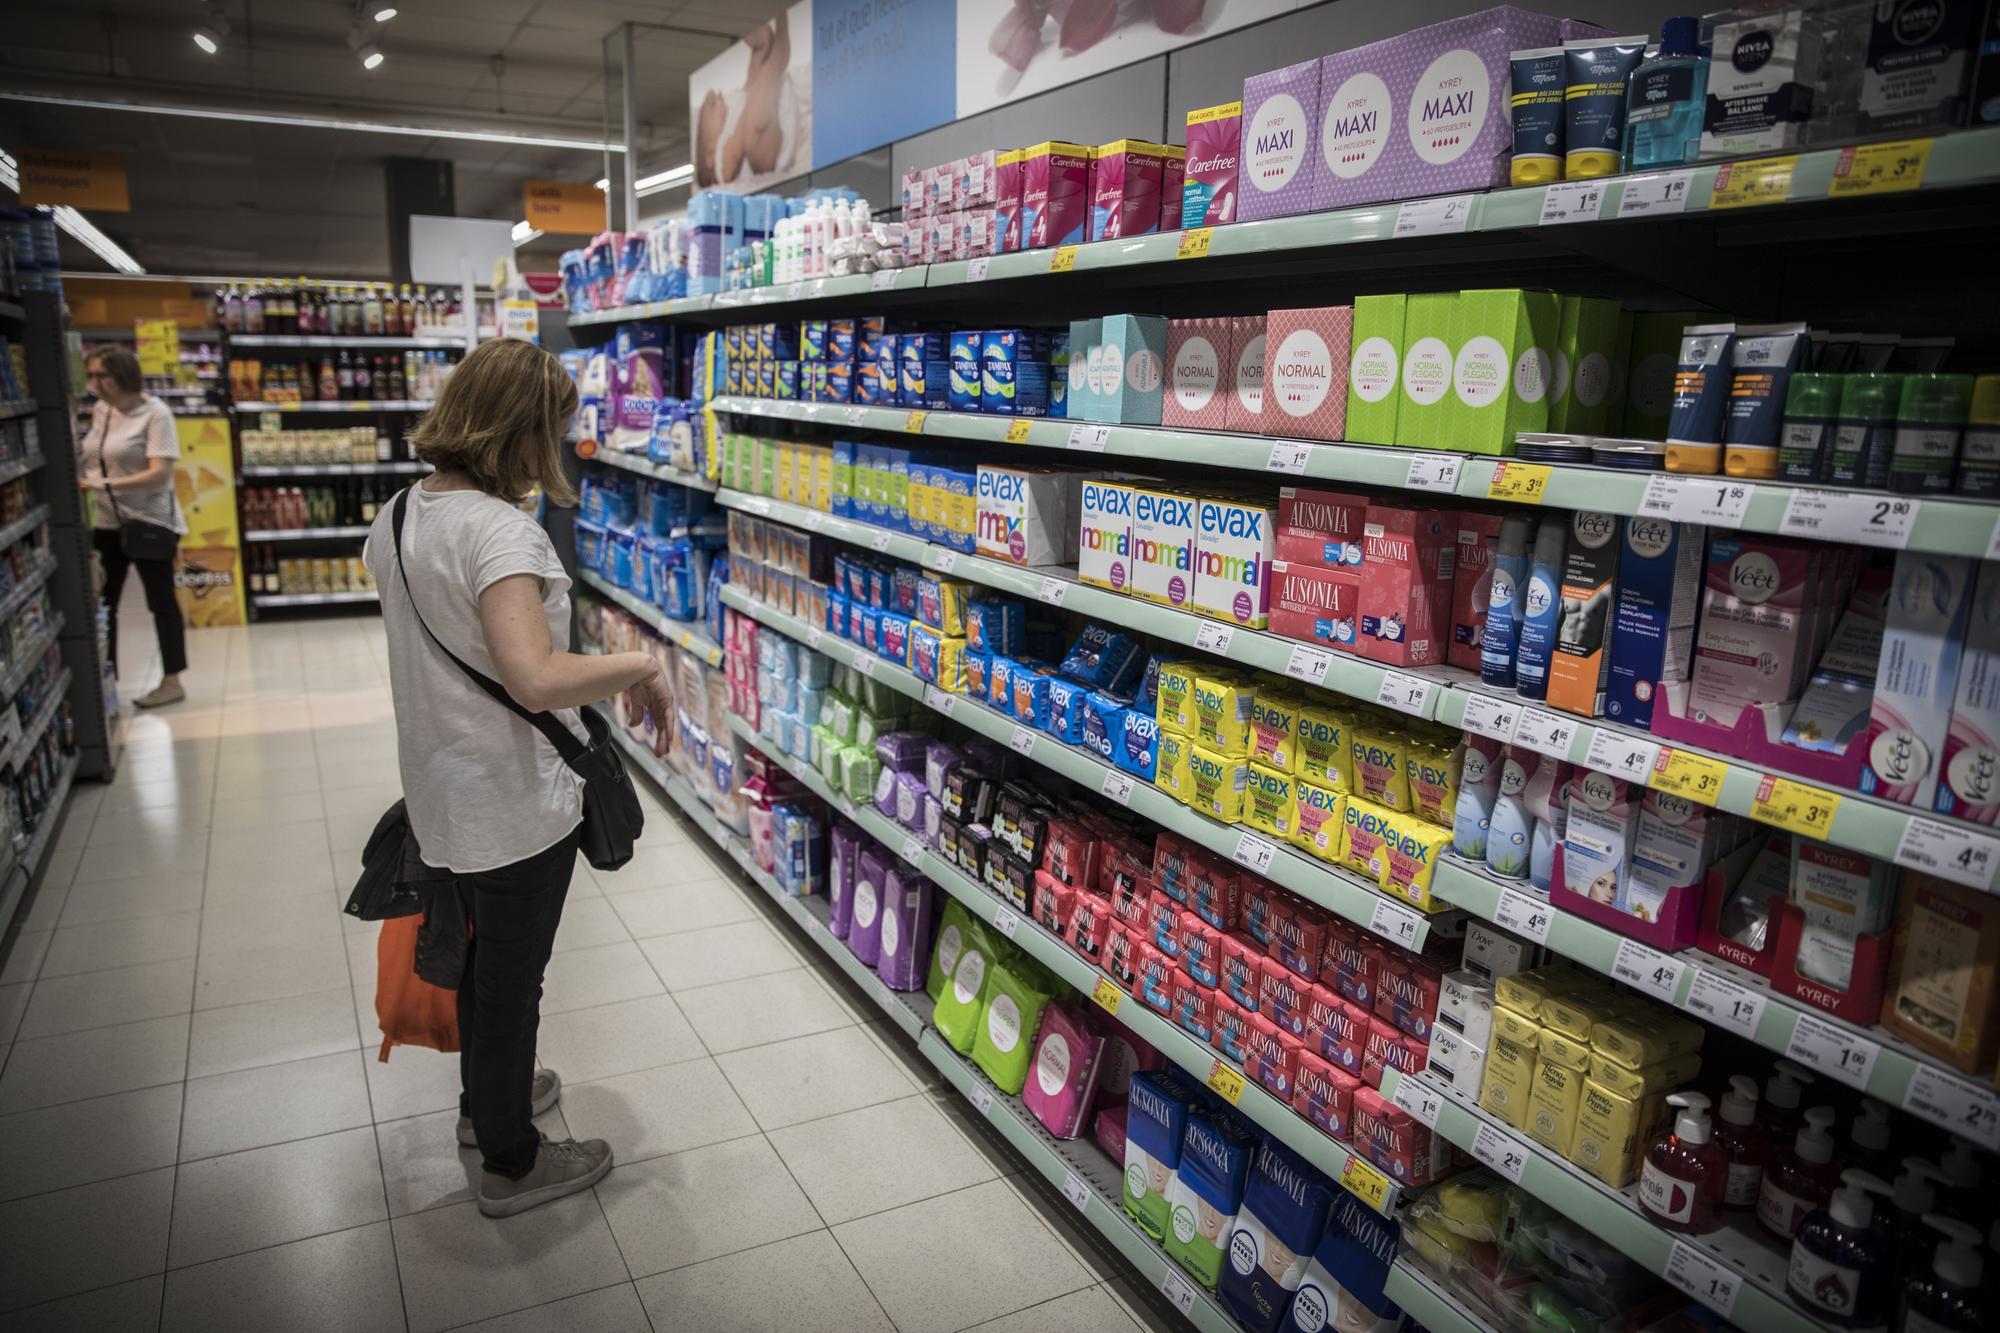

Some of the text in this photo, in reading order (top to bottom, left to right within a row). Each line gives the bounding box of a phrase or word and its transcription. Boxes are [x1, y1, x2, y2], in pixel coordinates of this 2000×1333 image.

[1737, 40, 1770, 56] NIVEA
[1534, 60, 1560, 69] KYREY
[1590, 64, 1617, 75] Men
[1439, 77, 1462, 89] KYREY
[1531, 74, 1556, 84] Men
[1647, 73, 1671, 84] KYREY
[1347, 98, 1367, 110] KYREY
[1422, 90, 1473, 122] MAXI
[1724, 96, 1768, 108] AFTER SHAVE
[1727, 103, 1764, 116] BALSAMO
[1267, 118, 1285, 127] KYREY
[1334, 110, 1377, 139] MAXI
[1256, 129, 1294, 155] MAXI
[1050, 155, 1086, 169] Carefree
[1126, 154, 1160, 168] Carefree
[1186, 154, 1236, 175] Carefree
[1024, 188, 1047, 203] Carefree
[1096, 188, 1121, 202] Carefree
[1185, 187, 1201, 196] normal
[1293, 350, 1310, 358] KYREY
[1746, 349, 1770, 361] Men
[954, 361, 978, 371] TAMPAX
[987, 361, 1011, 371] TAMPAX
[1177, 366, 1215, 378] NORMAL
[1278, 364, 1326, 378] NORMAL
[1359, 369, 1389, 377] PLEGADO
[1412, 370, 1444, 378] PLEGADO
[1413, 362, 1442, 370] NORMAL
[1463, 370, 1498, 378] PLEGADO
[1465, 362, 1497, 370] NORMAL
[979, 472, 1024, 502] evax
[1084, 486, 1131, 516] evax
[1137, 495, 1192, 529] evax
[1201, 504, 1262, 541] evax
[1289, 501, 1349, 534] AUSONIA
[1576, 512, 1611, 538] Veet
[1632, 520, 1667, 543] Veet
[1366, 538, 1409, 561] AUSONIA
[174, 570, 233, 587] Doritos
[1734, 565, 1776, 589] Veet
[919, 580, 939, 601] evax
[1281, 575, 1340, 611] AUSONIA
[1621, 595, 1654, 606] DEPILATORIA
[1622, 588, 1640, 596] CREMA
[1620, 602, 1638, 610] CREME
[882, 616, 907, 638] evax
[1082, 624, 1116, 648] evax
[914, 636, 936, 657] evax
[1159, 671, 1187, 693] evax
[1195, 688, 1224, 712] evax
[1125, 713, 1158, 741] evax
[1252, 704, 1292, 732] evax
[1299, 719, 1340, 745] evax
[1191, 754, 1223, 781] evax
[1353, 742, 1397, 770] evax
[1886, 732, 1913, 780] Veet
[1248, 769, 1289, 798] evax
[1407, 760, 1448, 788] evax
[1965, 750, 1995, 800] Veet
[1297, 782, 1337, 813] evax
[1584, 780, 1612, 801] Veet
[1659, 793, 1690, 816] Veet
[1346, 807, 1388, 838] evax
[1386, 829, 1428, 864] evax
[1160, 850, 1189, 877] AUSONIA
[1814, 851, 1856, 867] KYREY
[1190, 874, 1218, 902] AUSONIA
[1152, 903, 1179, 929] AUSONIA
[1270, 914, 1305, 949] AUSONIA
[1471, 929, 1494, 946] Dove
[1183, 930, 1212, 959] AUSONIA
[1326, 937, 1368, 975] AUSONIA
[1718, 943, 1756, 966] KYREY
[1139, 955, 1169, 984] AUSONIA
[1224, 954, 1253, 985] AUSONIA
[1174, 986, 1206, 1015] AUSONIA
[1262, 973, 1301, 1011] AUSONIA
[1381, 970, 1424, 1010] AUSONIA
[1445, 982, 1467, 1001] Dove
[1797, 984, 1840, 1009] KYREY
[1217, 1009, 1248, 1038] AUSONIA
[1310, 1001, 1354, 1041] AUSONIA
[1249, 1029, 1287, 1067] AUSONIA
[1435, 1031, 1457, 1051] Dove
[1041, 1048, 1066, 1073] NORMAL
[1368, 1032, 1415, 1074] AUSONIA
[1541, 1071, 1565, 1089] Pravia
[1542, 1062, 1562, 1079] Heno
[1298, 1065, 1338, 1108] AUSONIA
[1587, 1087, 1609, 1105] Heno
[1129, 1084, 1170, 1128] AUSONIA
[1586, 1096, 1612, 1116] Pravia
[1356, 1113, 1400, 1152] AUSONIA
[1186, 1122, 1230, 1173] AUSONIA
[1257, 1148, 1309, 1207] AUSONIA
[1337, 1201, 1398, 1266] AUSONIA
[1234, 1235, 1253, 1256] superplus
[1301, 1290, 1323, 1313] superplus
